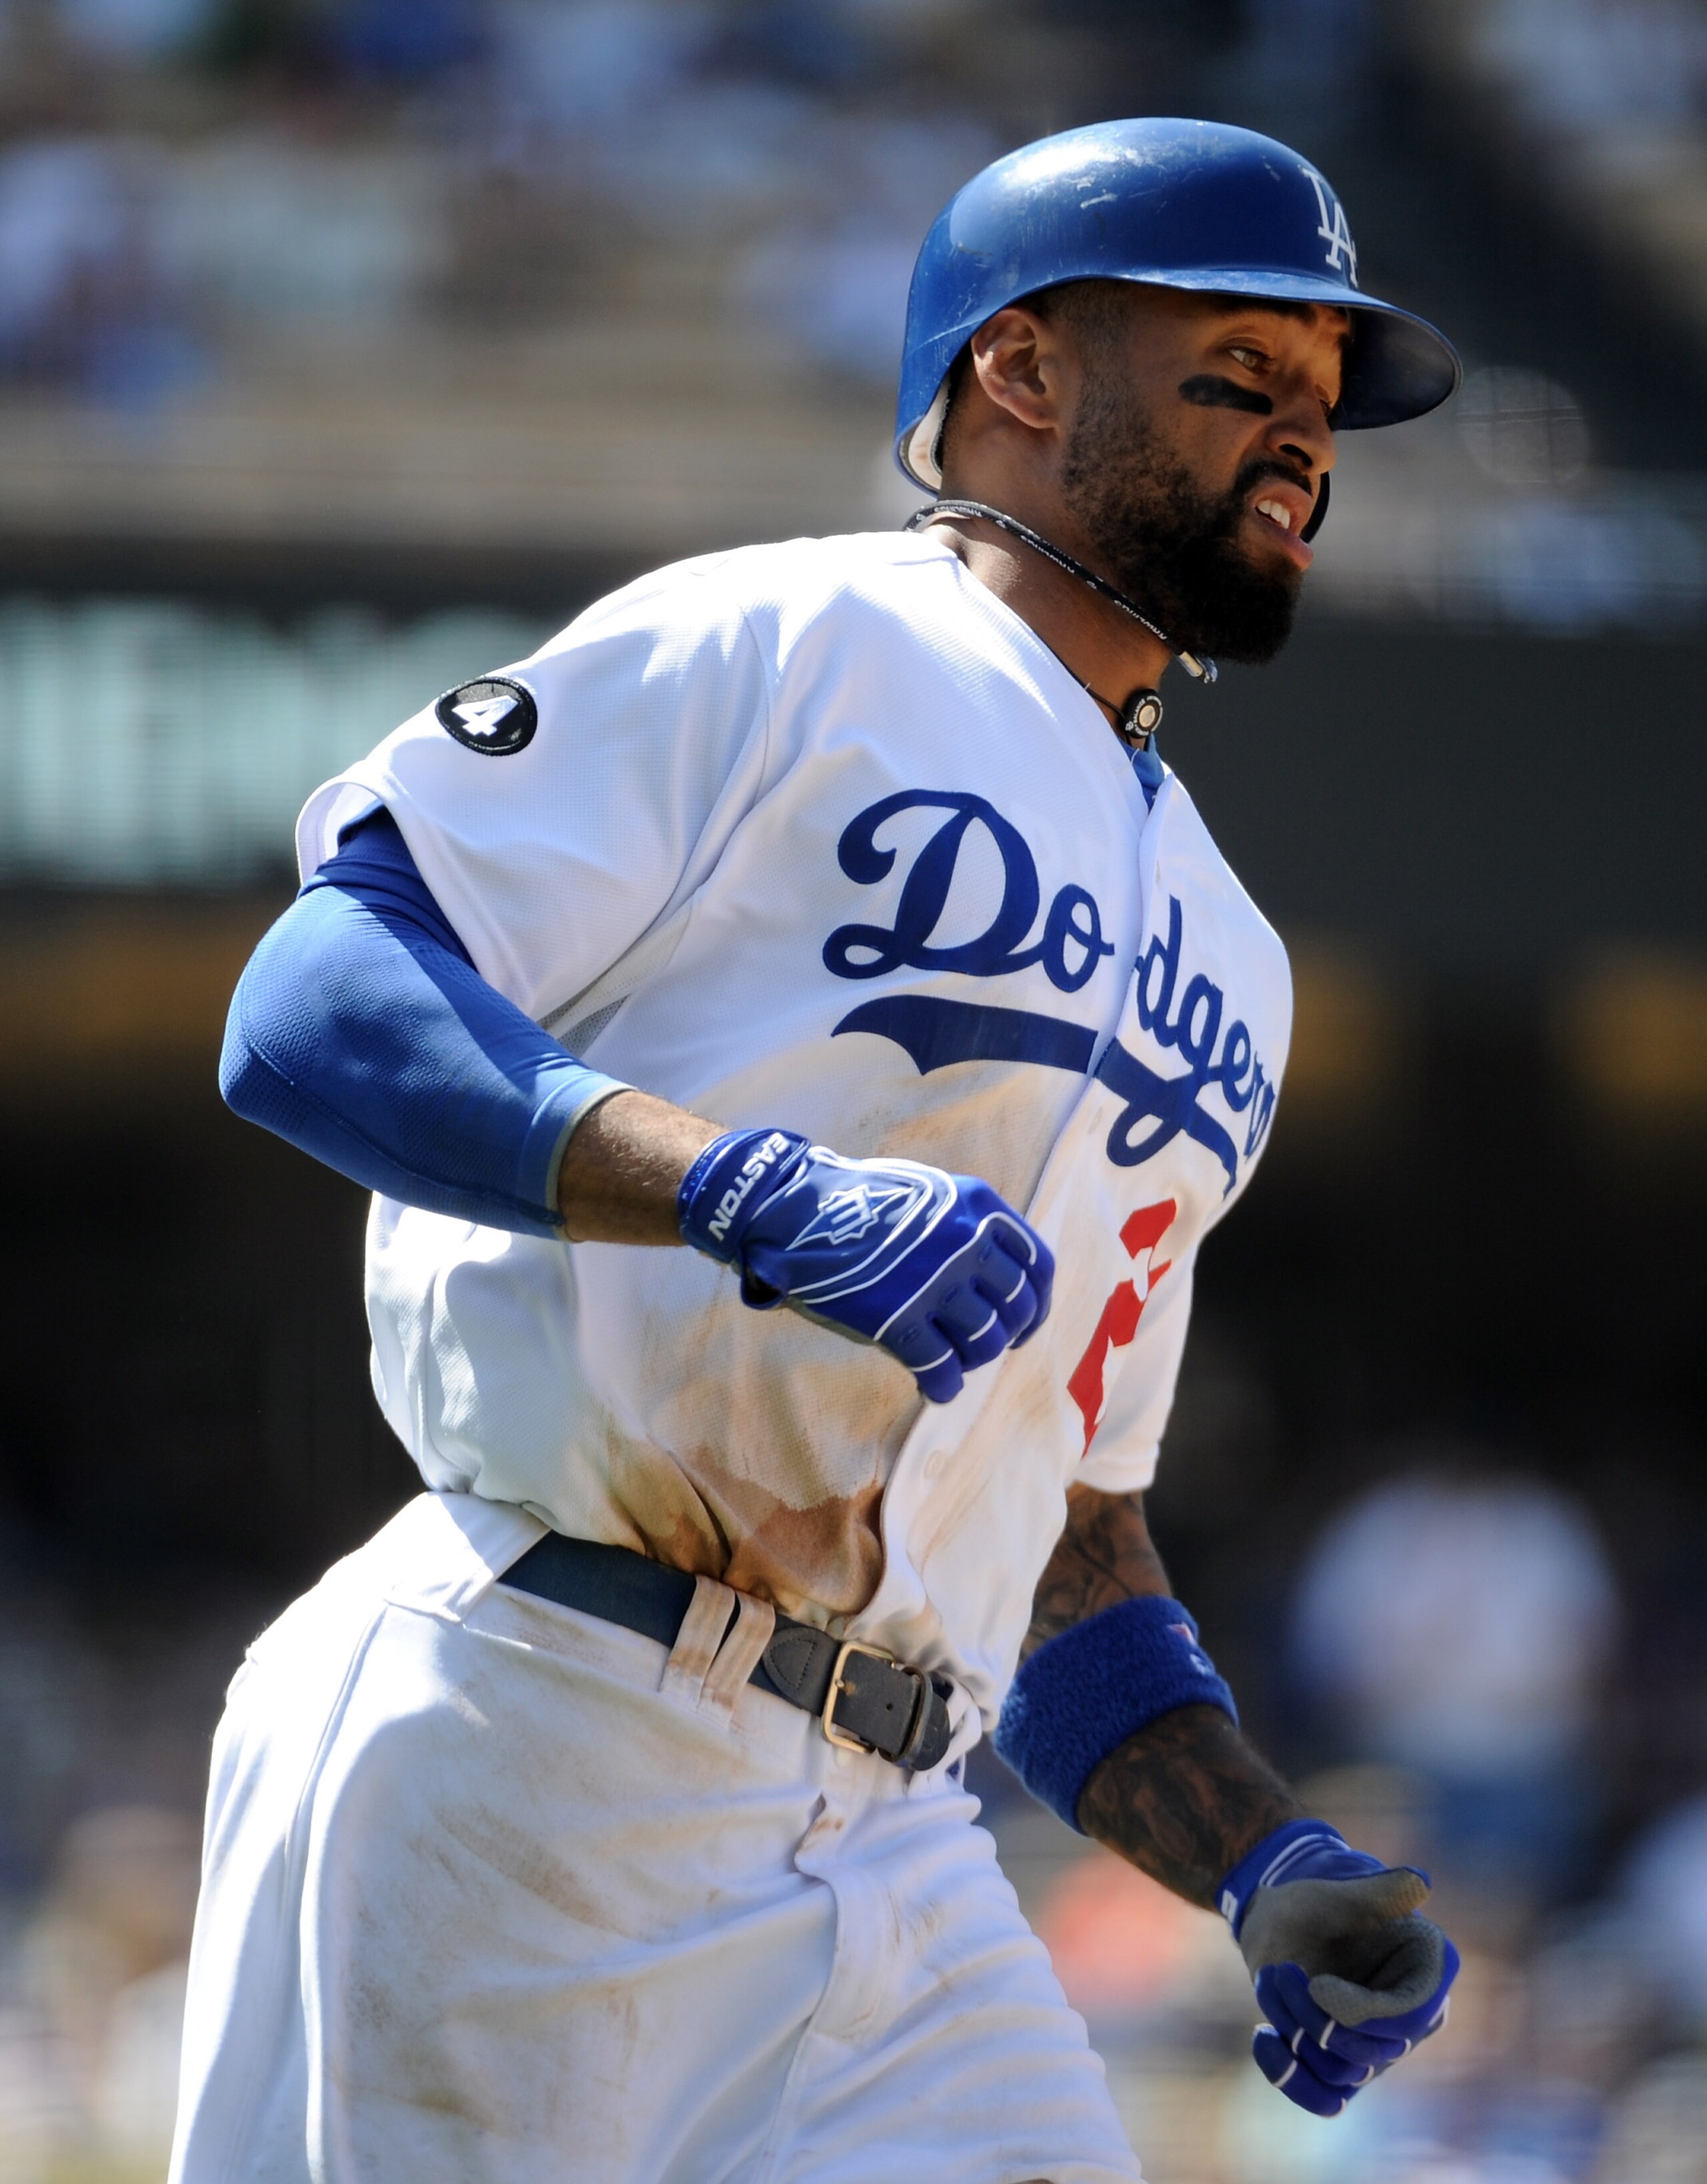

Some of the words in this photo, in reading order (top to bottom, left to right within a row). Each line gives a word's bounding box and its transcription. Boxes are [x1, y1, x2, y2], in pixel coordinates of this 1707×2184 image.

[1302, 167, 1358, 289] LA
[451, 695, 519, 737] 4
[822, 788, 1275, 1167] Dodgers
[708, 1131, 789, 1242] EASTON
